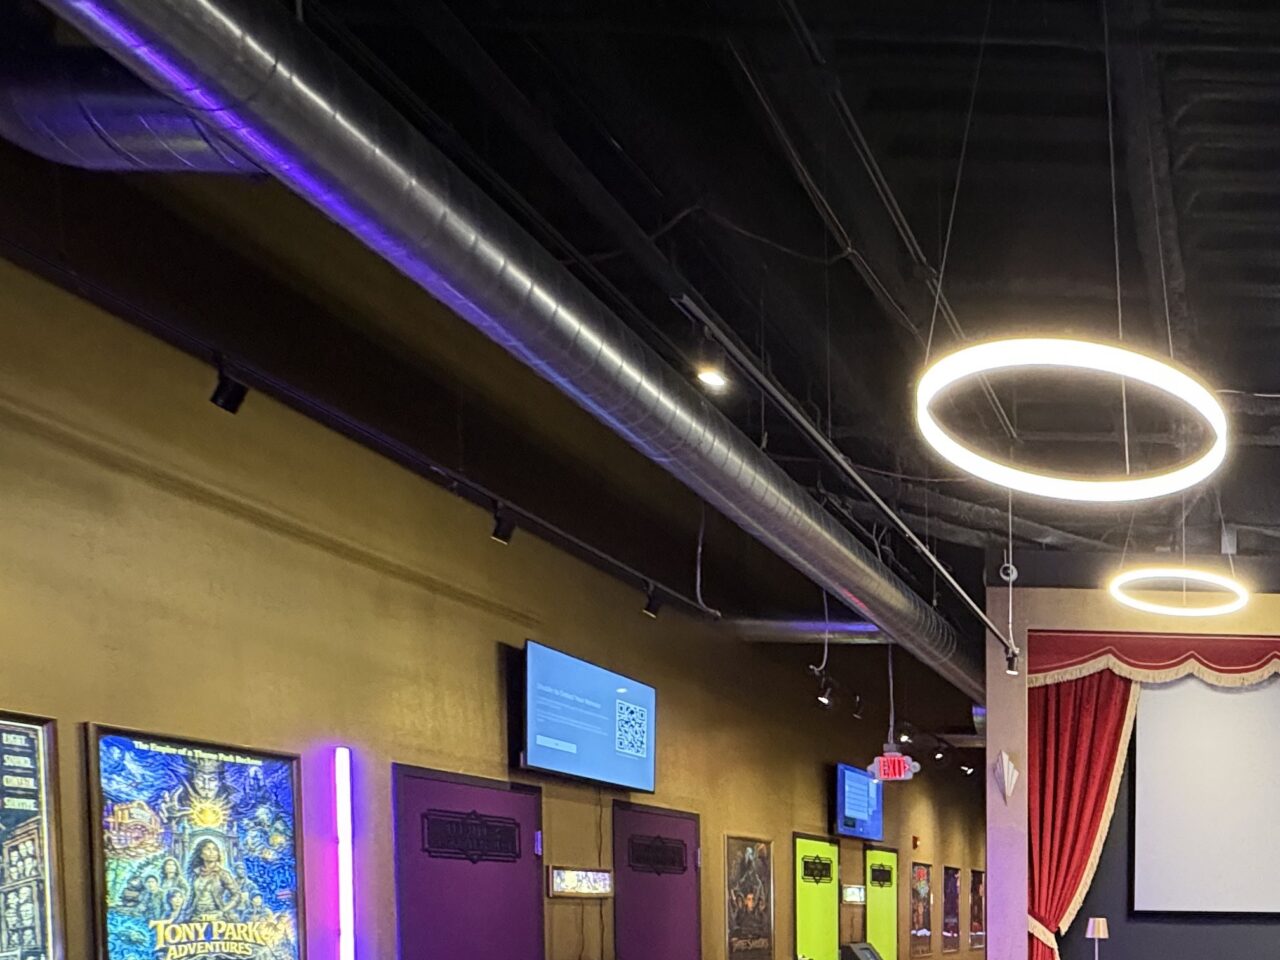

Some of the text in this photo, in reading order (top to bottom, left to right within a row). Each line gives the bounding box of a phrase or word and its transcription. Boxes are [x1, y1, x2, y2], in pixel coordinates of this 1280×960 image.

[132, 740, 150, 752] The
[881, 757, 905, 778] EXIT
[149, 919, 266, 950] TONY PARK
